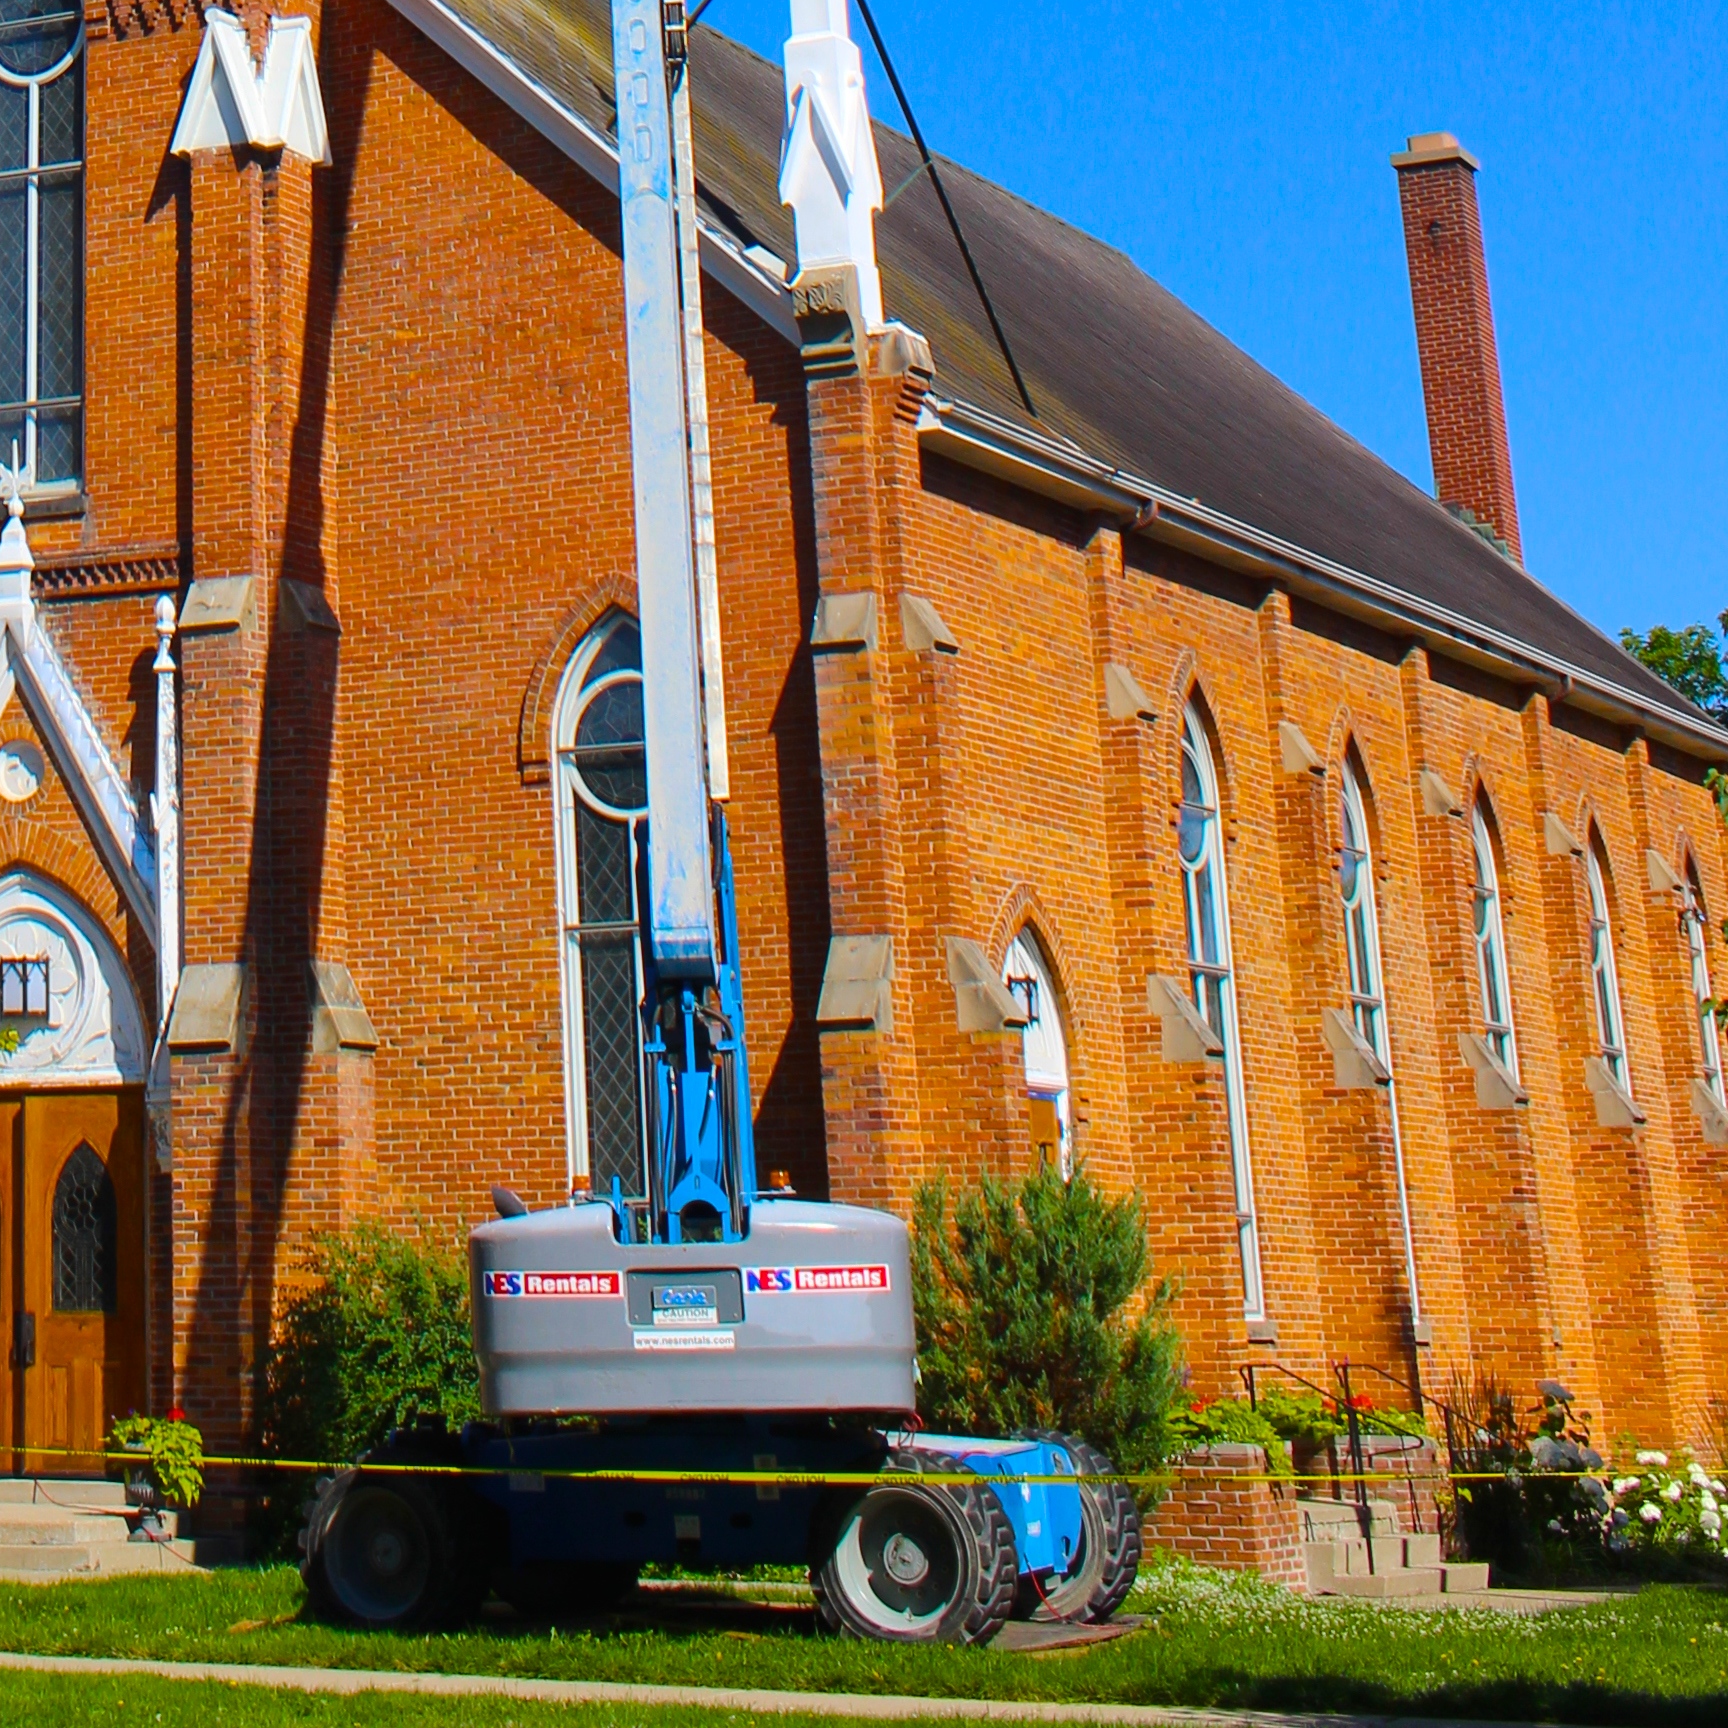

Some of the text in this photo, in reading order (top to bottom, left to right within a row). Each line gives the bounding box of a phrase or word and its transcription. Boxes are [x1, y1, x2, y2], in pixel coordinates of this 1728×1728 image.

[485, 1272, 612, 1295] NES Rentals
[747, 1268, 882, 1292] NES Rentals
[662, 1308, 709, 1318] CAUTION
[635, 1336, 734, 1346] www.nesrentals.com
